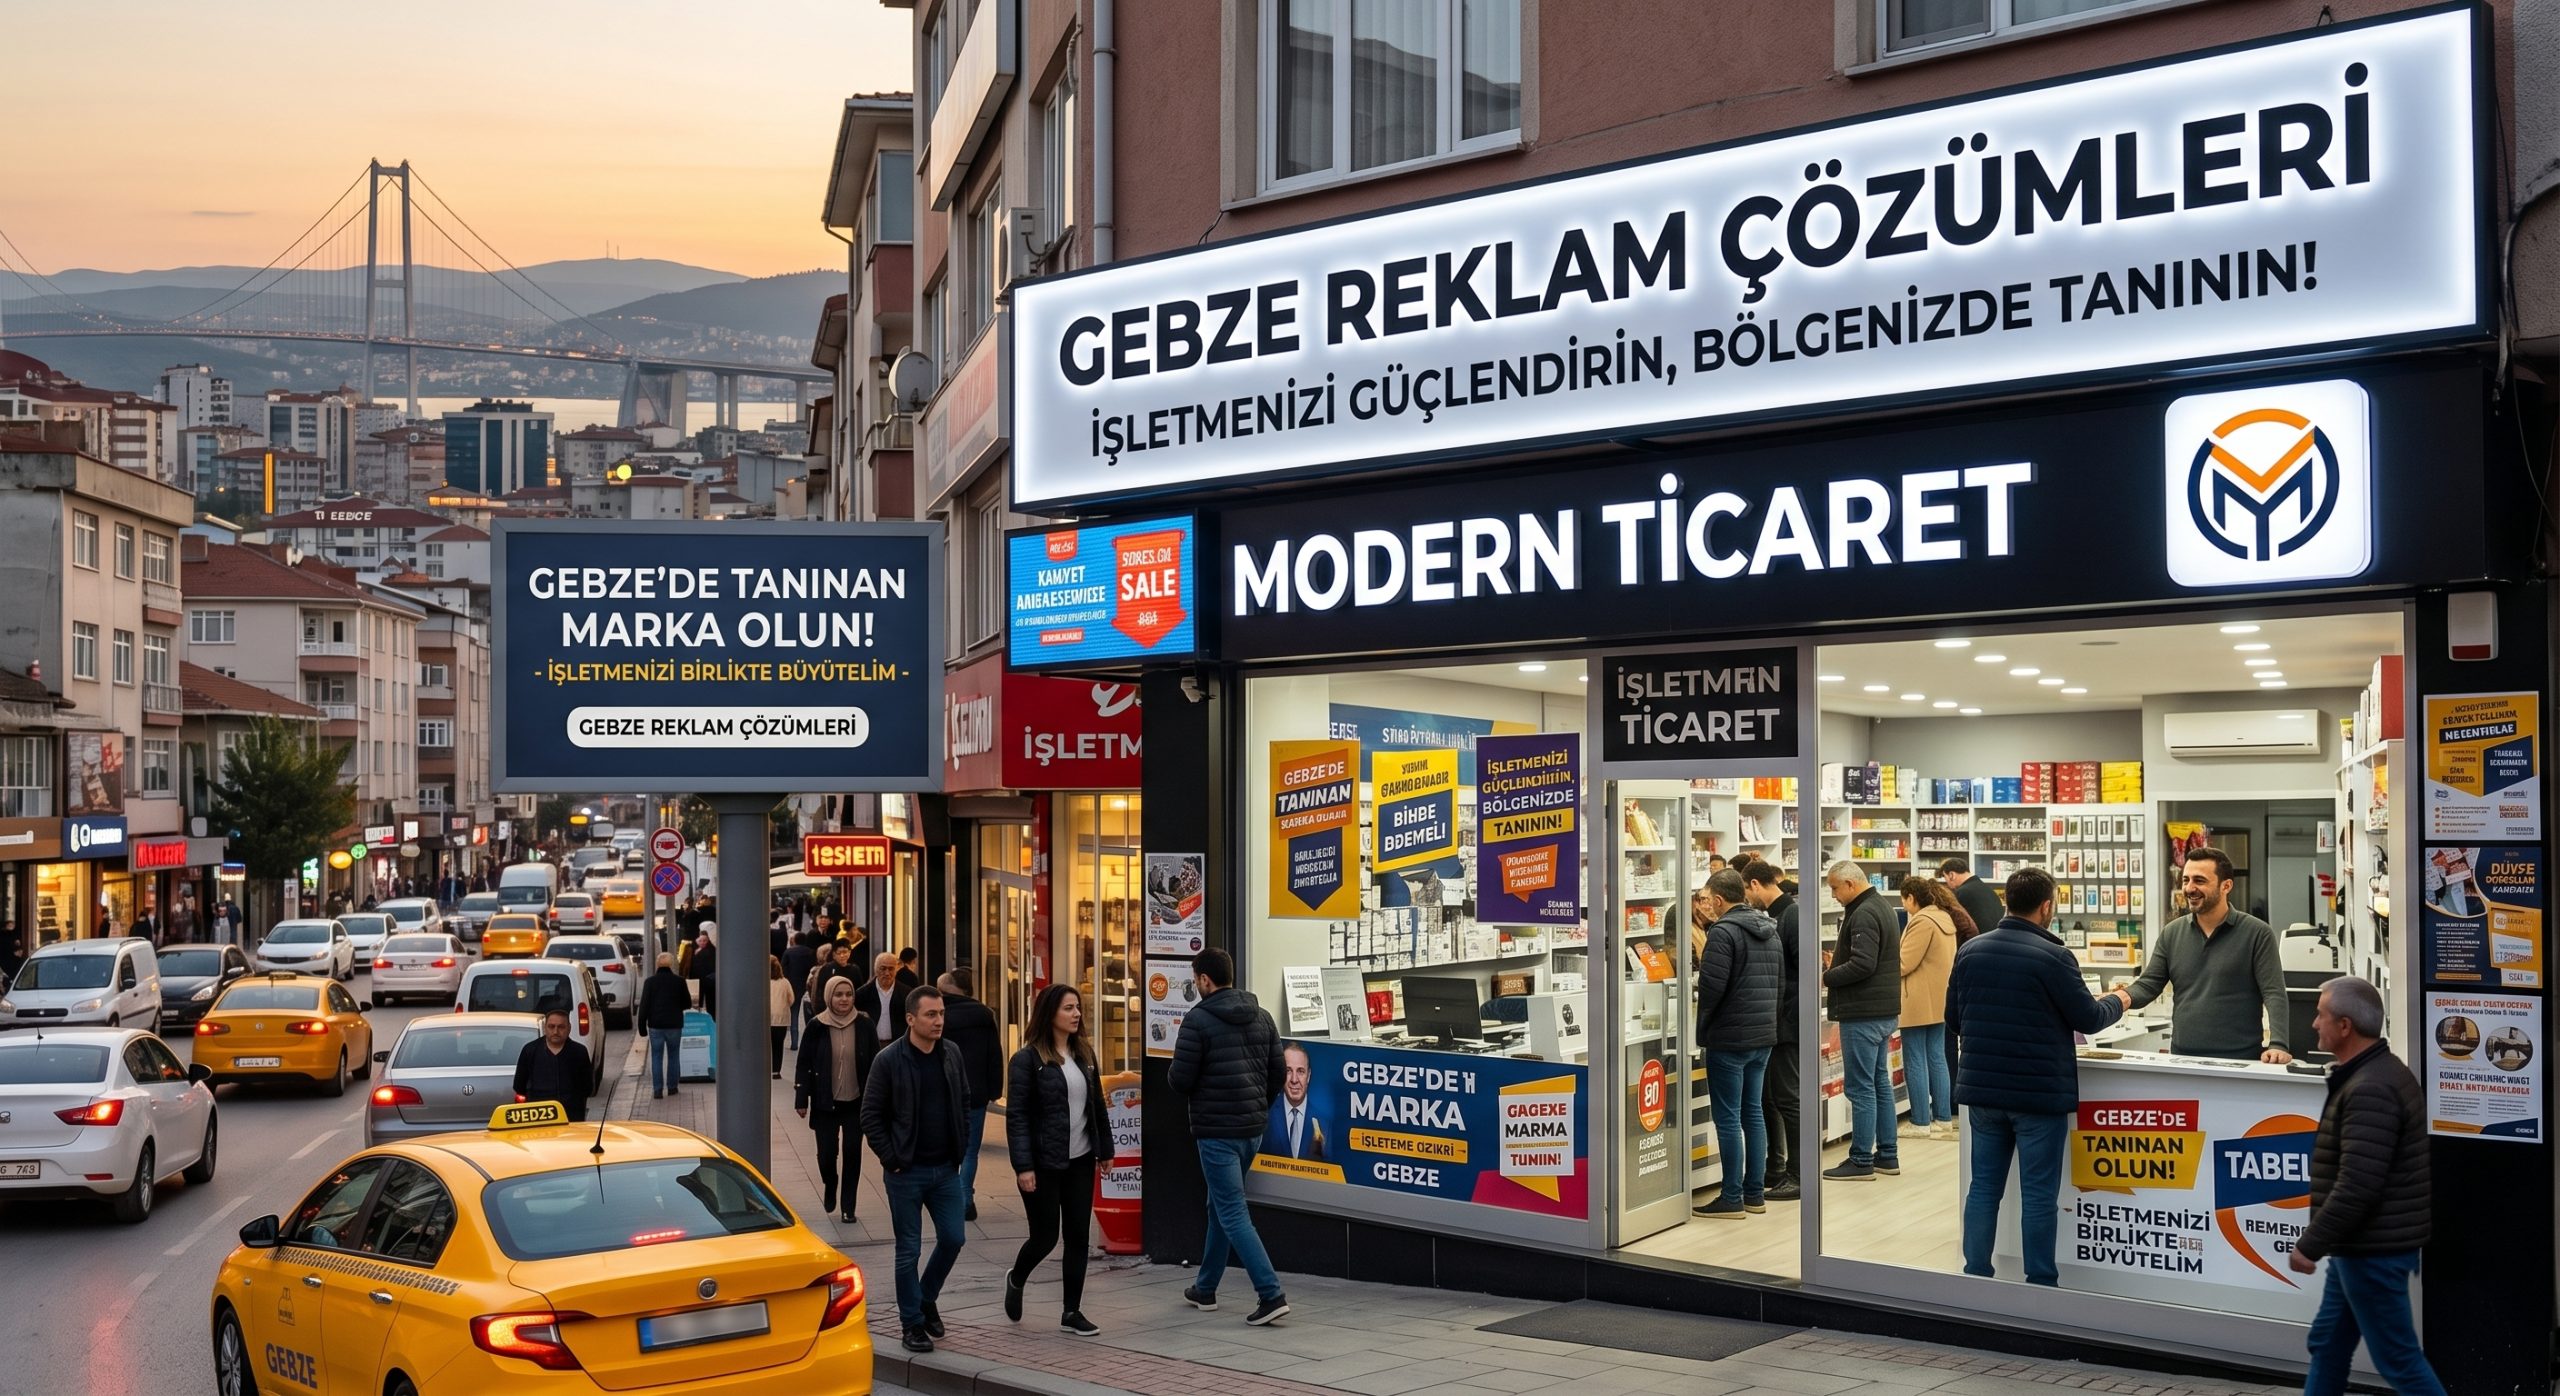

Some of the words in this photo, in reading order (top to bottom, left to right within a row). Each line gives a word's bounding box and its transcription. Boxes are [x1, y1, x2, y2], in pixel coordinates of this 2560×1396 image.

[1060, 279, 1300, 387] GEBZE
[1327, 210, 1687, 345] REKLAM
[1720, 62, 2371, 304] ÇÖZÜMLERİ
[1091, 371, 1336, 467] İŞLETMENİZİ
[1348, 327, 1678, 425] GÜÇLENDİRİN,
[1694, 284, 2032, 373] BÖLGENİZDE
[2049, 240, 2318, 323] TANININ!
[1233, 508, 1583, 616] MODERN
[1602, 461, 2036, 586] TİCARET
[528, 565, 720, 600] GEBZE’DE
[731, 567, 906, 600] TANINAN
[1121, 568, 1177, 601] SALE
[562, 611, 725, 648] MARKA
[737, 611, 874, 648] OLUN!
[547, 657, 675, 686] İŞLETMENİZİ
[681, 657, 772, 681] BİRLİKTE
[779, 658, 897, 682] BÜYÜTELİM
[579, 717, 645, 736] GEBZE
[650, 717, 734, 736] REKLAM
[739, 713, 857, 741] ÇÖZÜMLERİ
[1619, 704, 1781, 745] TİCARET
[1278, 783, 1352, 813] TANINAN
[1493, 813, 1563, 837] TANININ!
[1342, 1060, 1459, 1093] GEBZE'DE
[1350, 1091, 1467, 1132] MARKA
[2093, 1109, 2187, 1127] GEBZE'DE
[1505, 1121, 1568, 1138] MARMA
[2082, 1135, 2184, 1154] TANINAN
[1373, 1161, 1440, 1188] GEBZE
[2093, 1157, 2176, 1180] OLUN!
[2076, 1197, 2210, 1232] İŞLETMENİZİ
[2076, 1220, 2179, 1250] BİRLİKTE
[2076, 1242, 2204, 1275] BÜYÜTELİM
[265, 1342, 319, 1390] GEBZE
